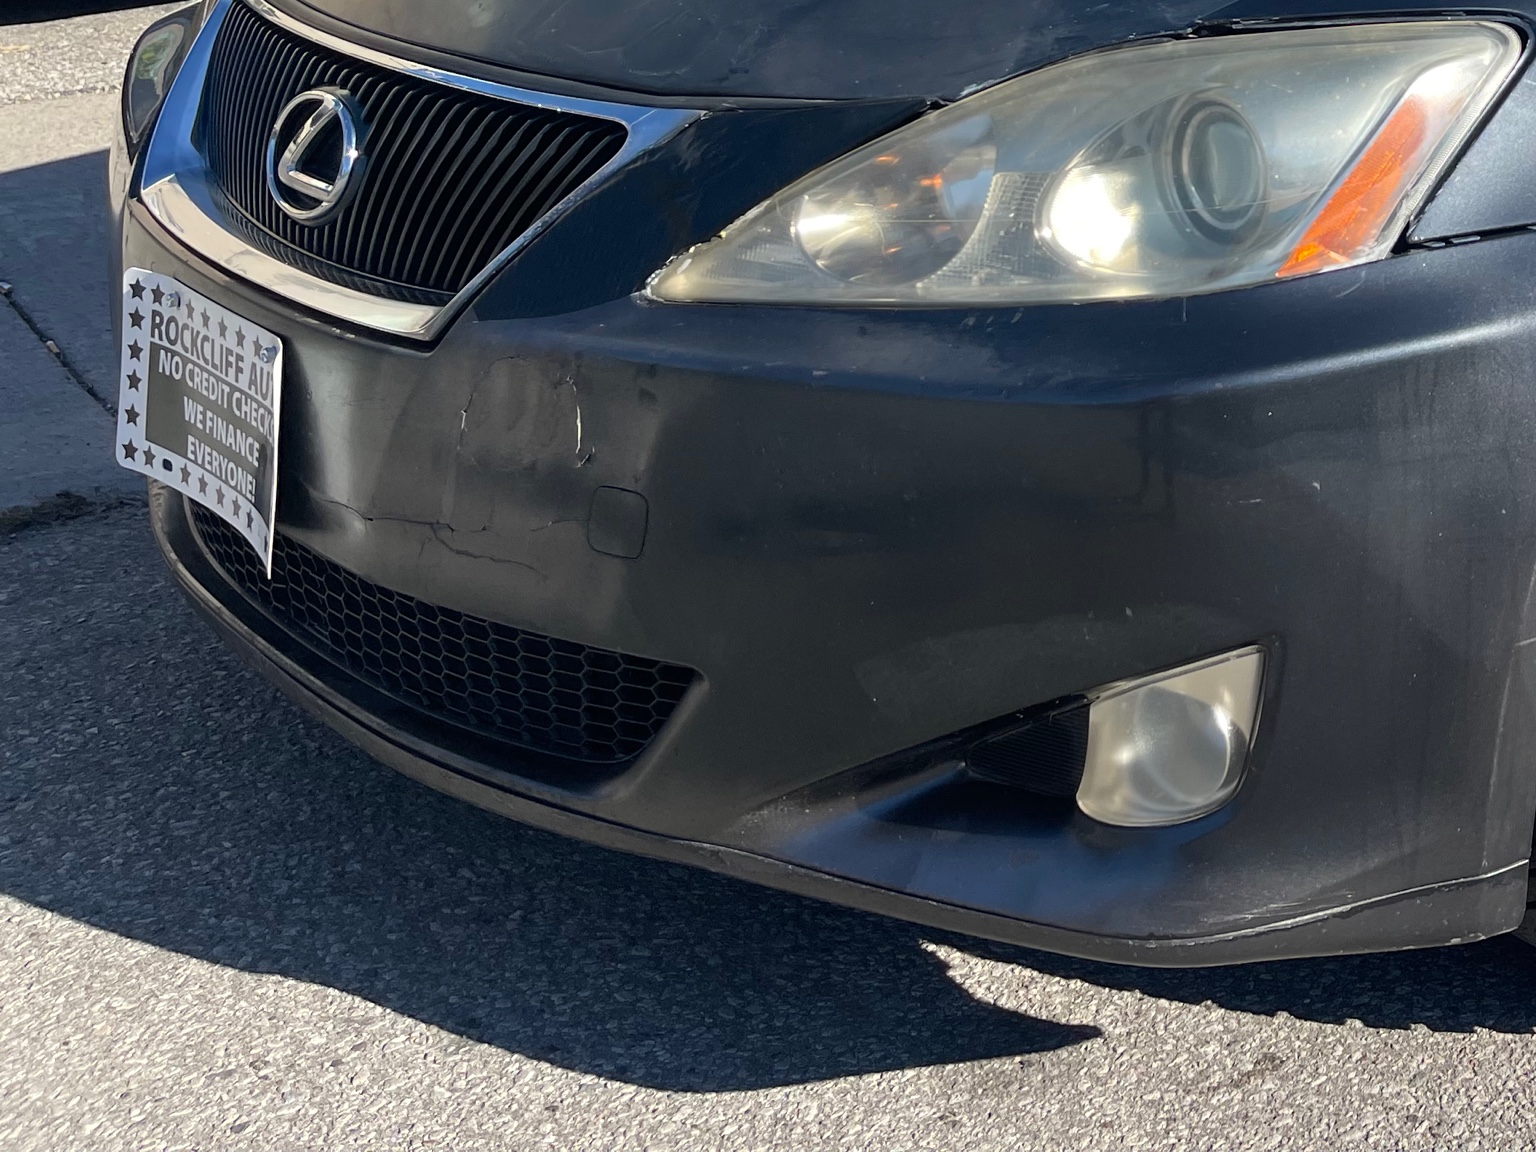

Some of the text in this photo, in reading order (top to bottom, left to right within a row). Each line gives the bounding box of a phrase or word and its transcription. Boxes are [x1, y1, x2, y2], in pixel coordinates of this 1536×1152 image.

[150, 308, 273, 403] ROCKCLIFF AU
[158, 349, 183, 380] NO
[185, 364, 231, 408] CREDIT
[183, 396, 261, 468] WE FINANCE
[187, 434, 256, 504] EVERYONE!
